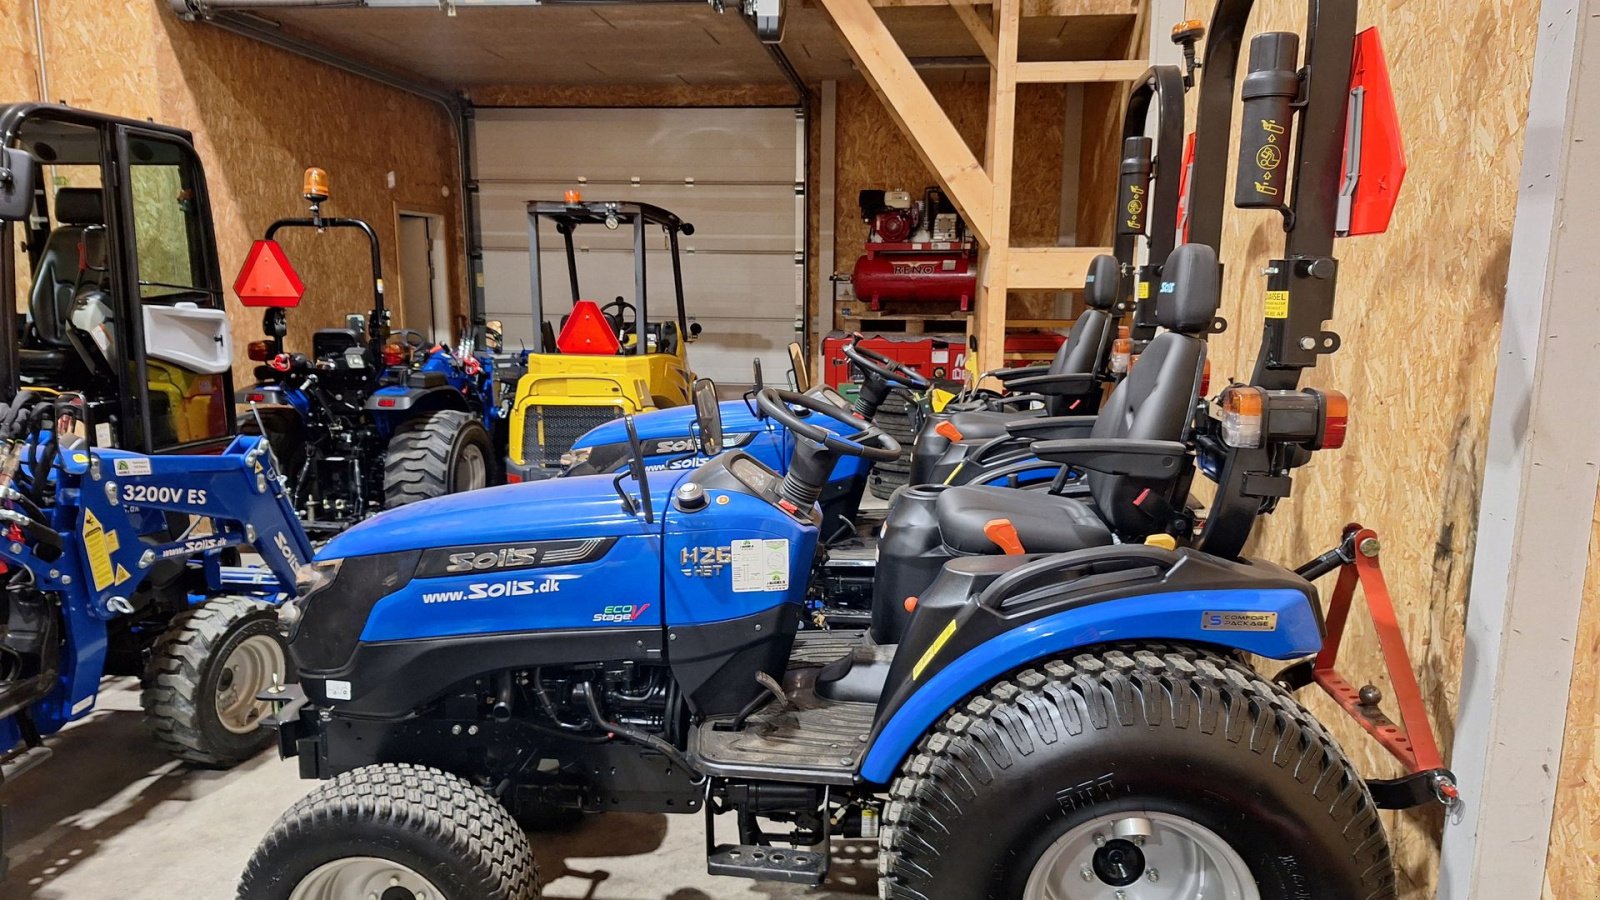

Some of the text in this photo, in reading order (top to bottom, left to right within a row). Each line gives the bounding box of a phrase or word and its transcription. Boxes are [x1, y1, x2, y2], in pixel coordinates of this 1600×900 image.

[894, 264, 934, 274] RENO
[122, 484, 207, 505] 3200V ES
[423, 580, 560, 604] www.Solis.dk
[604, 605, 632, 613] ECO
[632, 604, 650, 620] V
